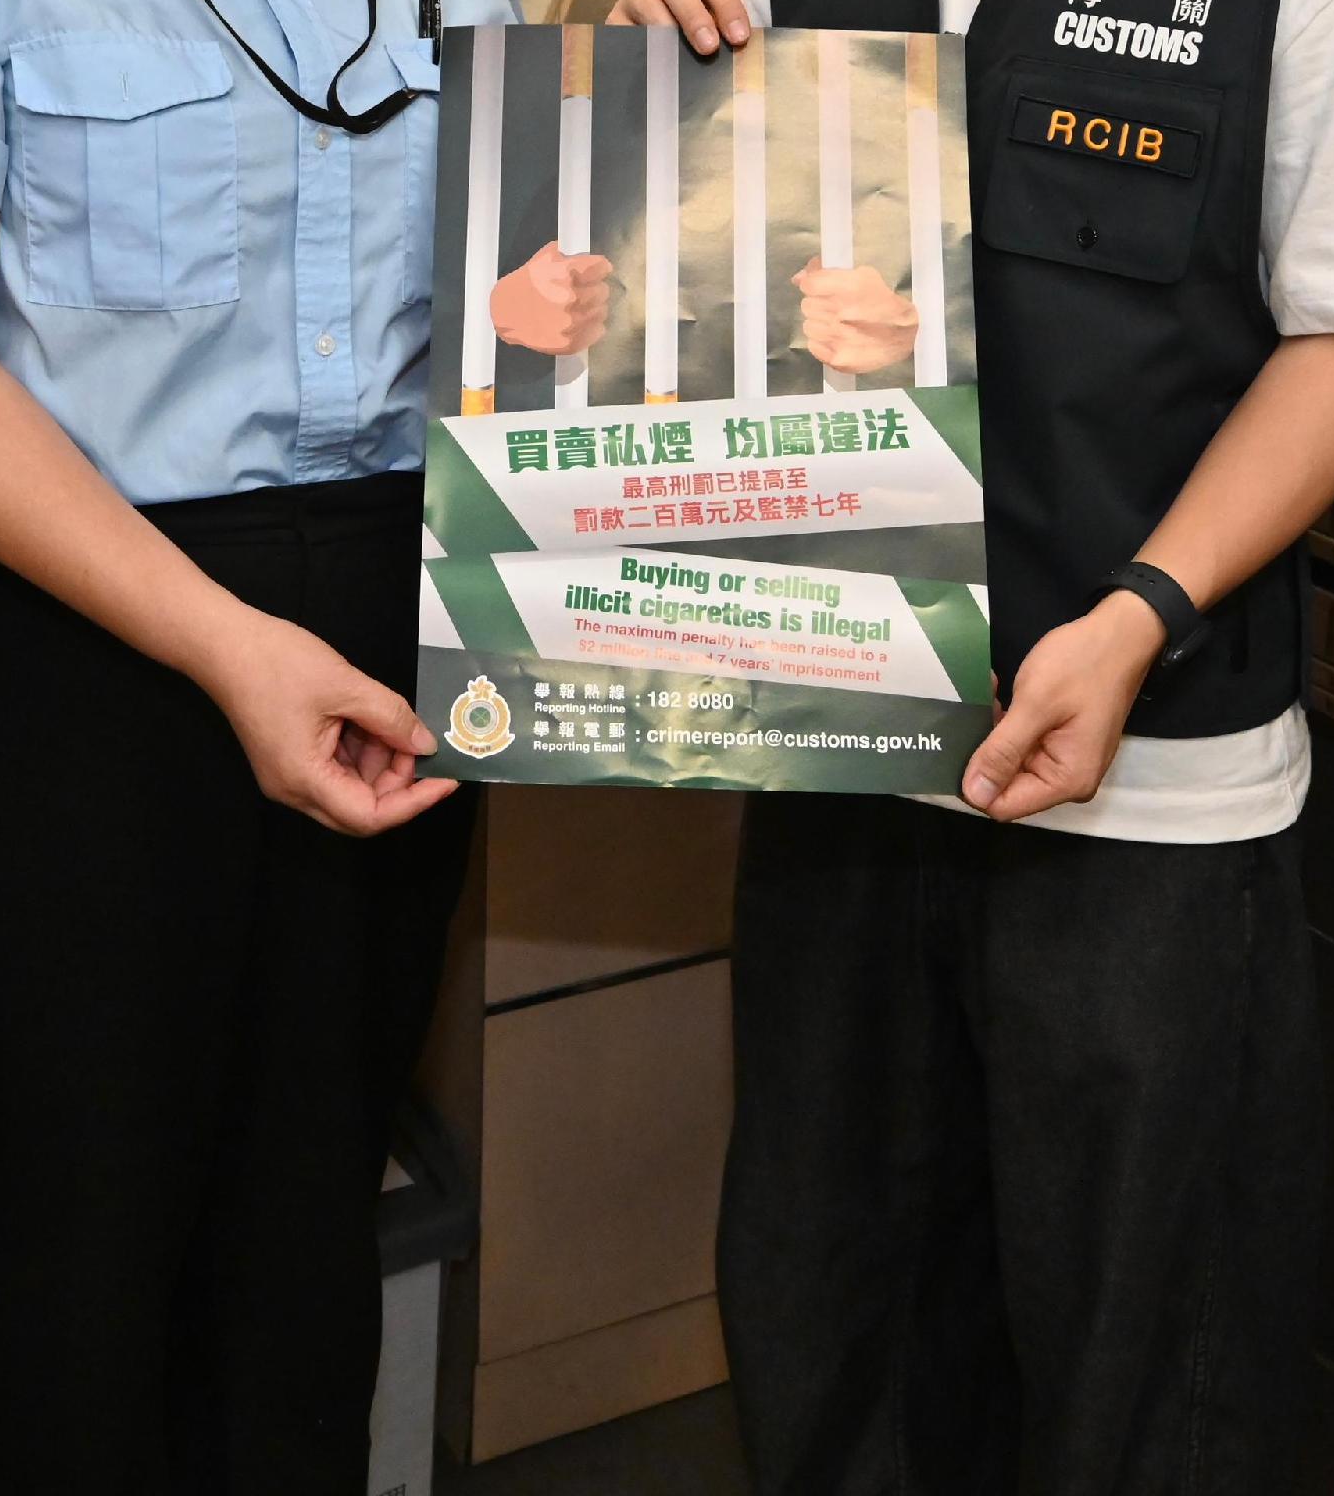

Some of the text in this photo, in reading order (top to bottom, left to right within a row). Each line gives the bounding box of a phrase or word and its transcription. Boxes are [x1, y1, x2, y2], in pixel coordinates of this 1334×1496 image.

[1053, 10, 1204, 66] CUSTOMS
[1046, 108, 1165, 164] RCIB
[505, 408, 911, 474] 買賣私煙 均屬違法
[622, 467, 808, 500] 最高刑罰已提高至
[573, 491, 862, 534] 罰款二百萬元及監禁七年
[620, 557, 841, 608] Buying or selling
[564, 584, 891, 644] illicit cigarettes is illegal
[574, 617, 602, 634] The
[605, 622, 678, 642] maximum
[681, 630, 736, 651] penalty
[770, 637, 807, 655] been
[810, 641, 856, 660] raised
[860, 648, 875, 662] to
[878, 653, 888, 663] a
[578, 639, 596, 654] $2
[599, 640, 650, 660] million
[716, 654, 727, 664] 7
[779, 660, 882, 683] imprisonment
[534, 702, 626, 715] Reporting Hotline
[647, 690, 681, 709] 182
[687, 692, 734, 710] 8080
[533, 740, 626, 754] Reporting Email
[647, 726, 943, 754] crimereport@customs.gov.hk
